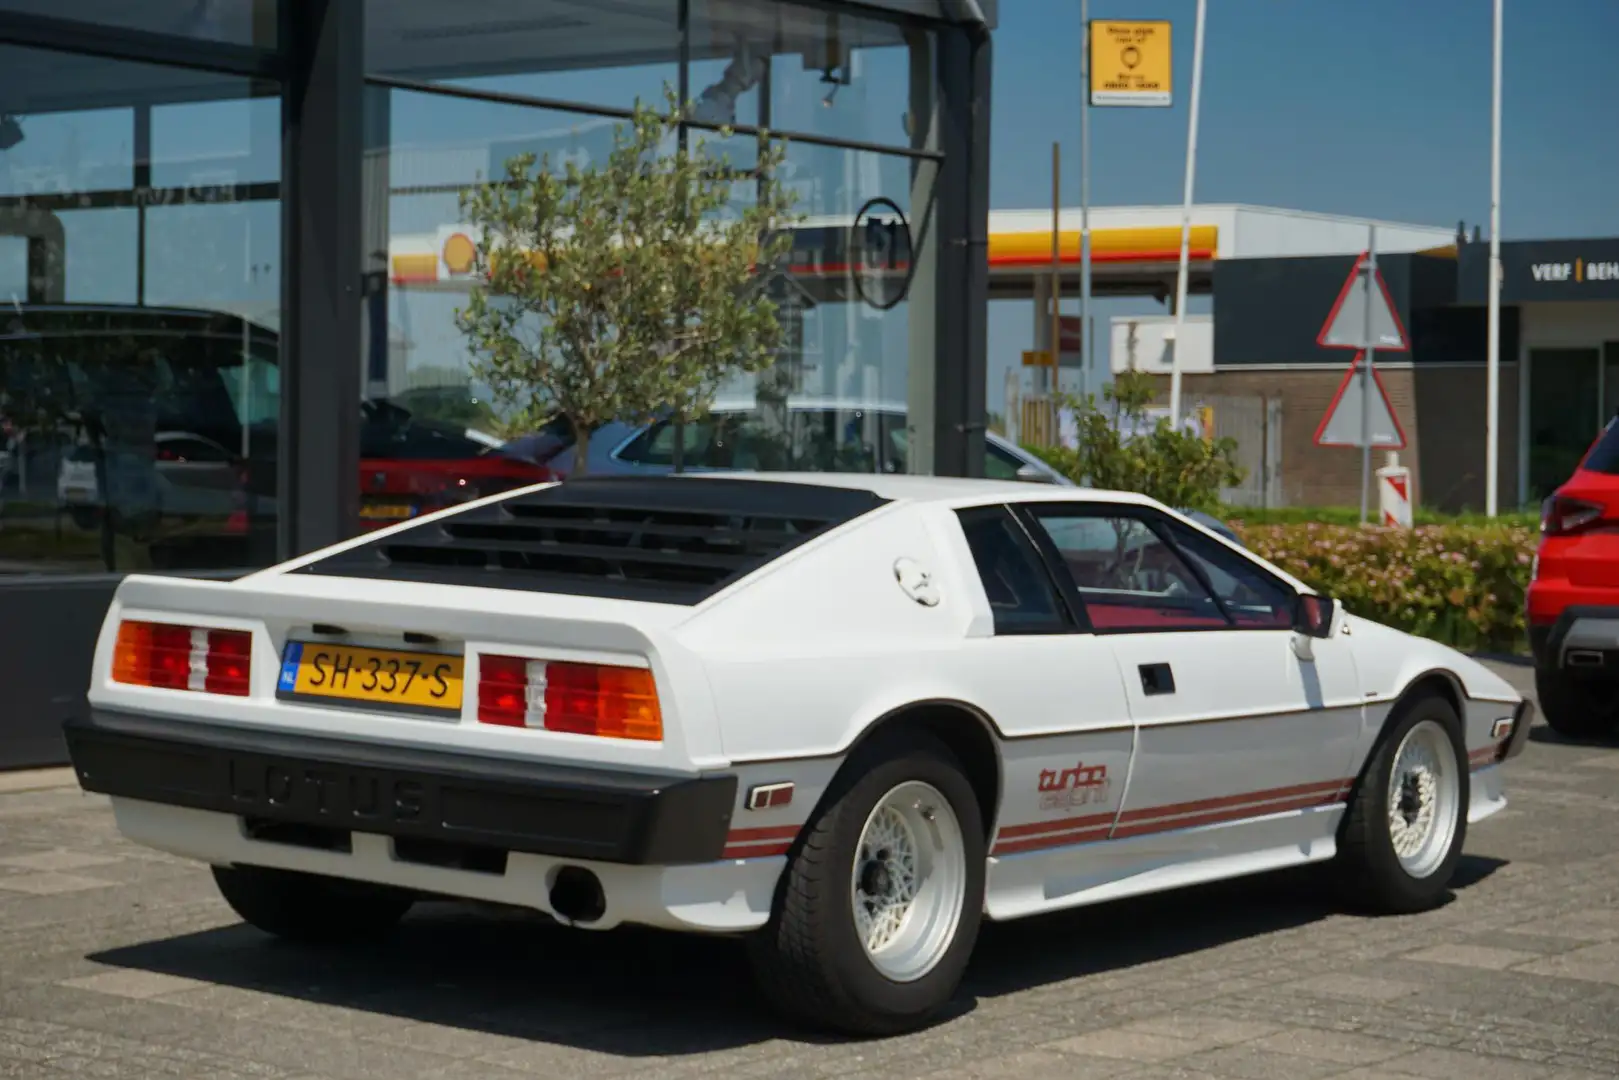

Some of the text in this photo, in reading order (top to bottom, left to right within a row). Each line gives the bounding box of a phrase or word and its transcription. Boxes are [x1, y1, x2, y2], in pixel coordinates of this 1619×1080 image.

[1532, 262, 1619, 281] VERF BEH
[229, 759, 425, 823] LOTUS
[1038, 761, 1107, 791] turbo
